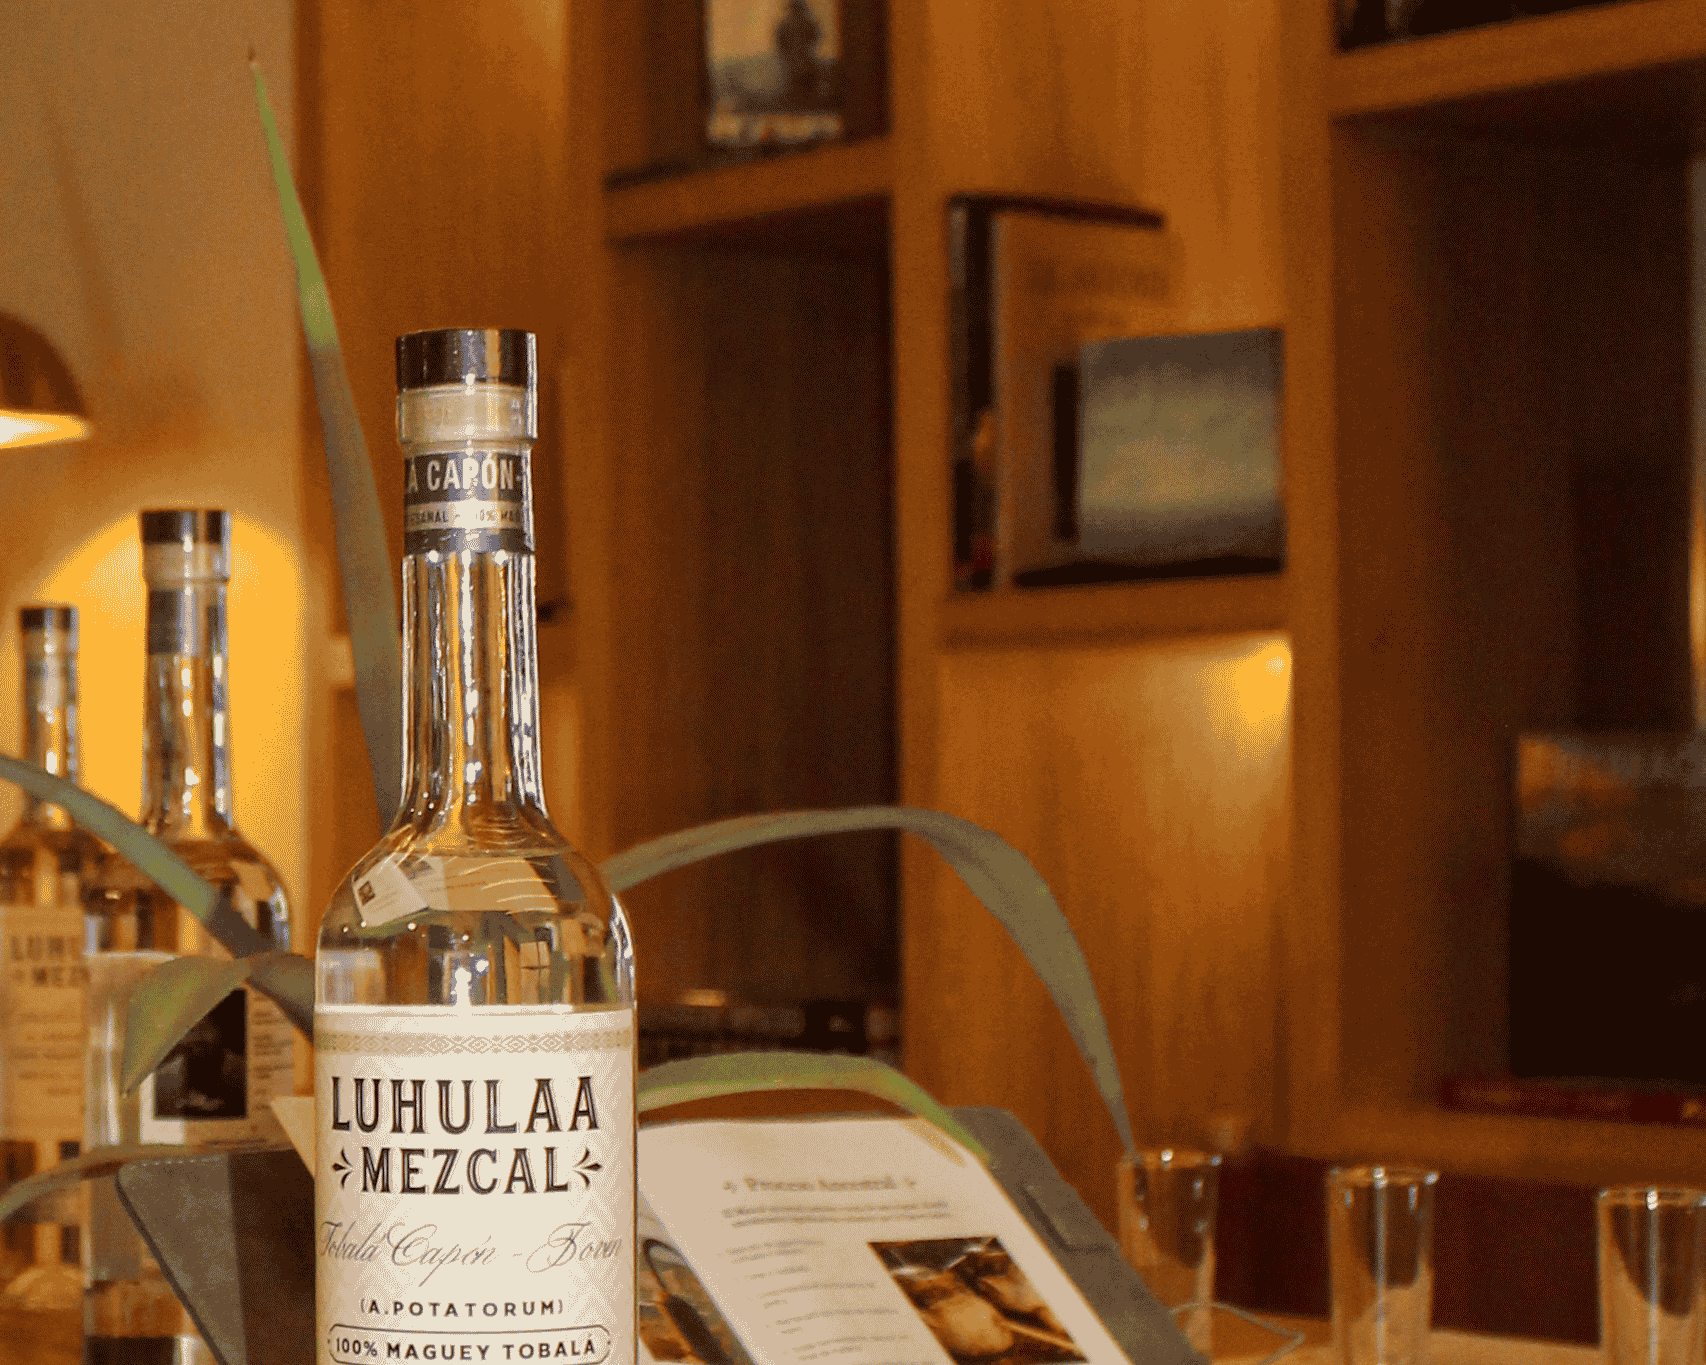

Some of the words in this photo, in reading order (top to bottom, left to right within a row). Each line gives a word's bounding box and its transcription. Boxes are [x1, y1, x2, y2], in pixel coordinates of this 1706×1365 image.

[427, 453, 513, 491] CAPÓN
[331, 1075, 600, 1135] LUHULAA
[361, 1146, 570, 1195] MEZCAL
[336, 1335, 379, 1358] 100%
[386, 1341, 491, 1362] MAGUEY
[502, 1334, 596, 1361] TOBALÁ
